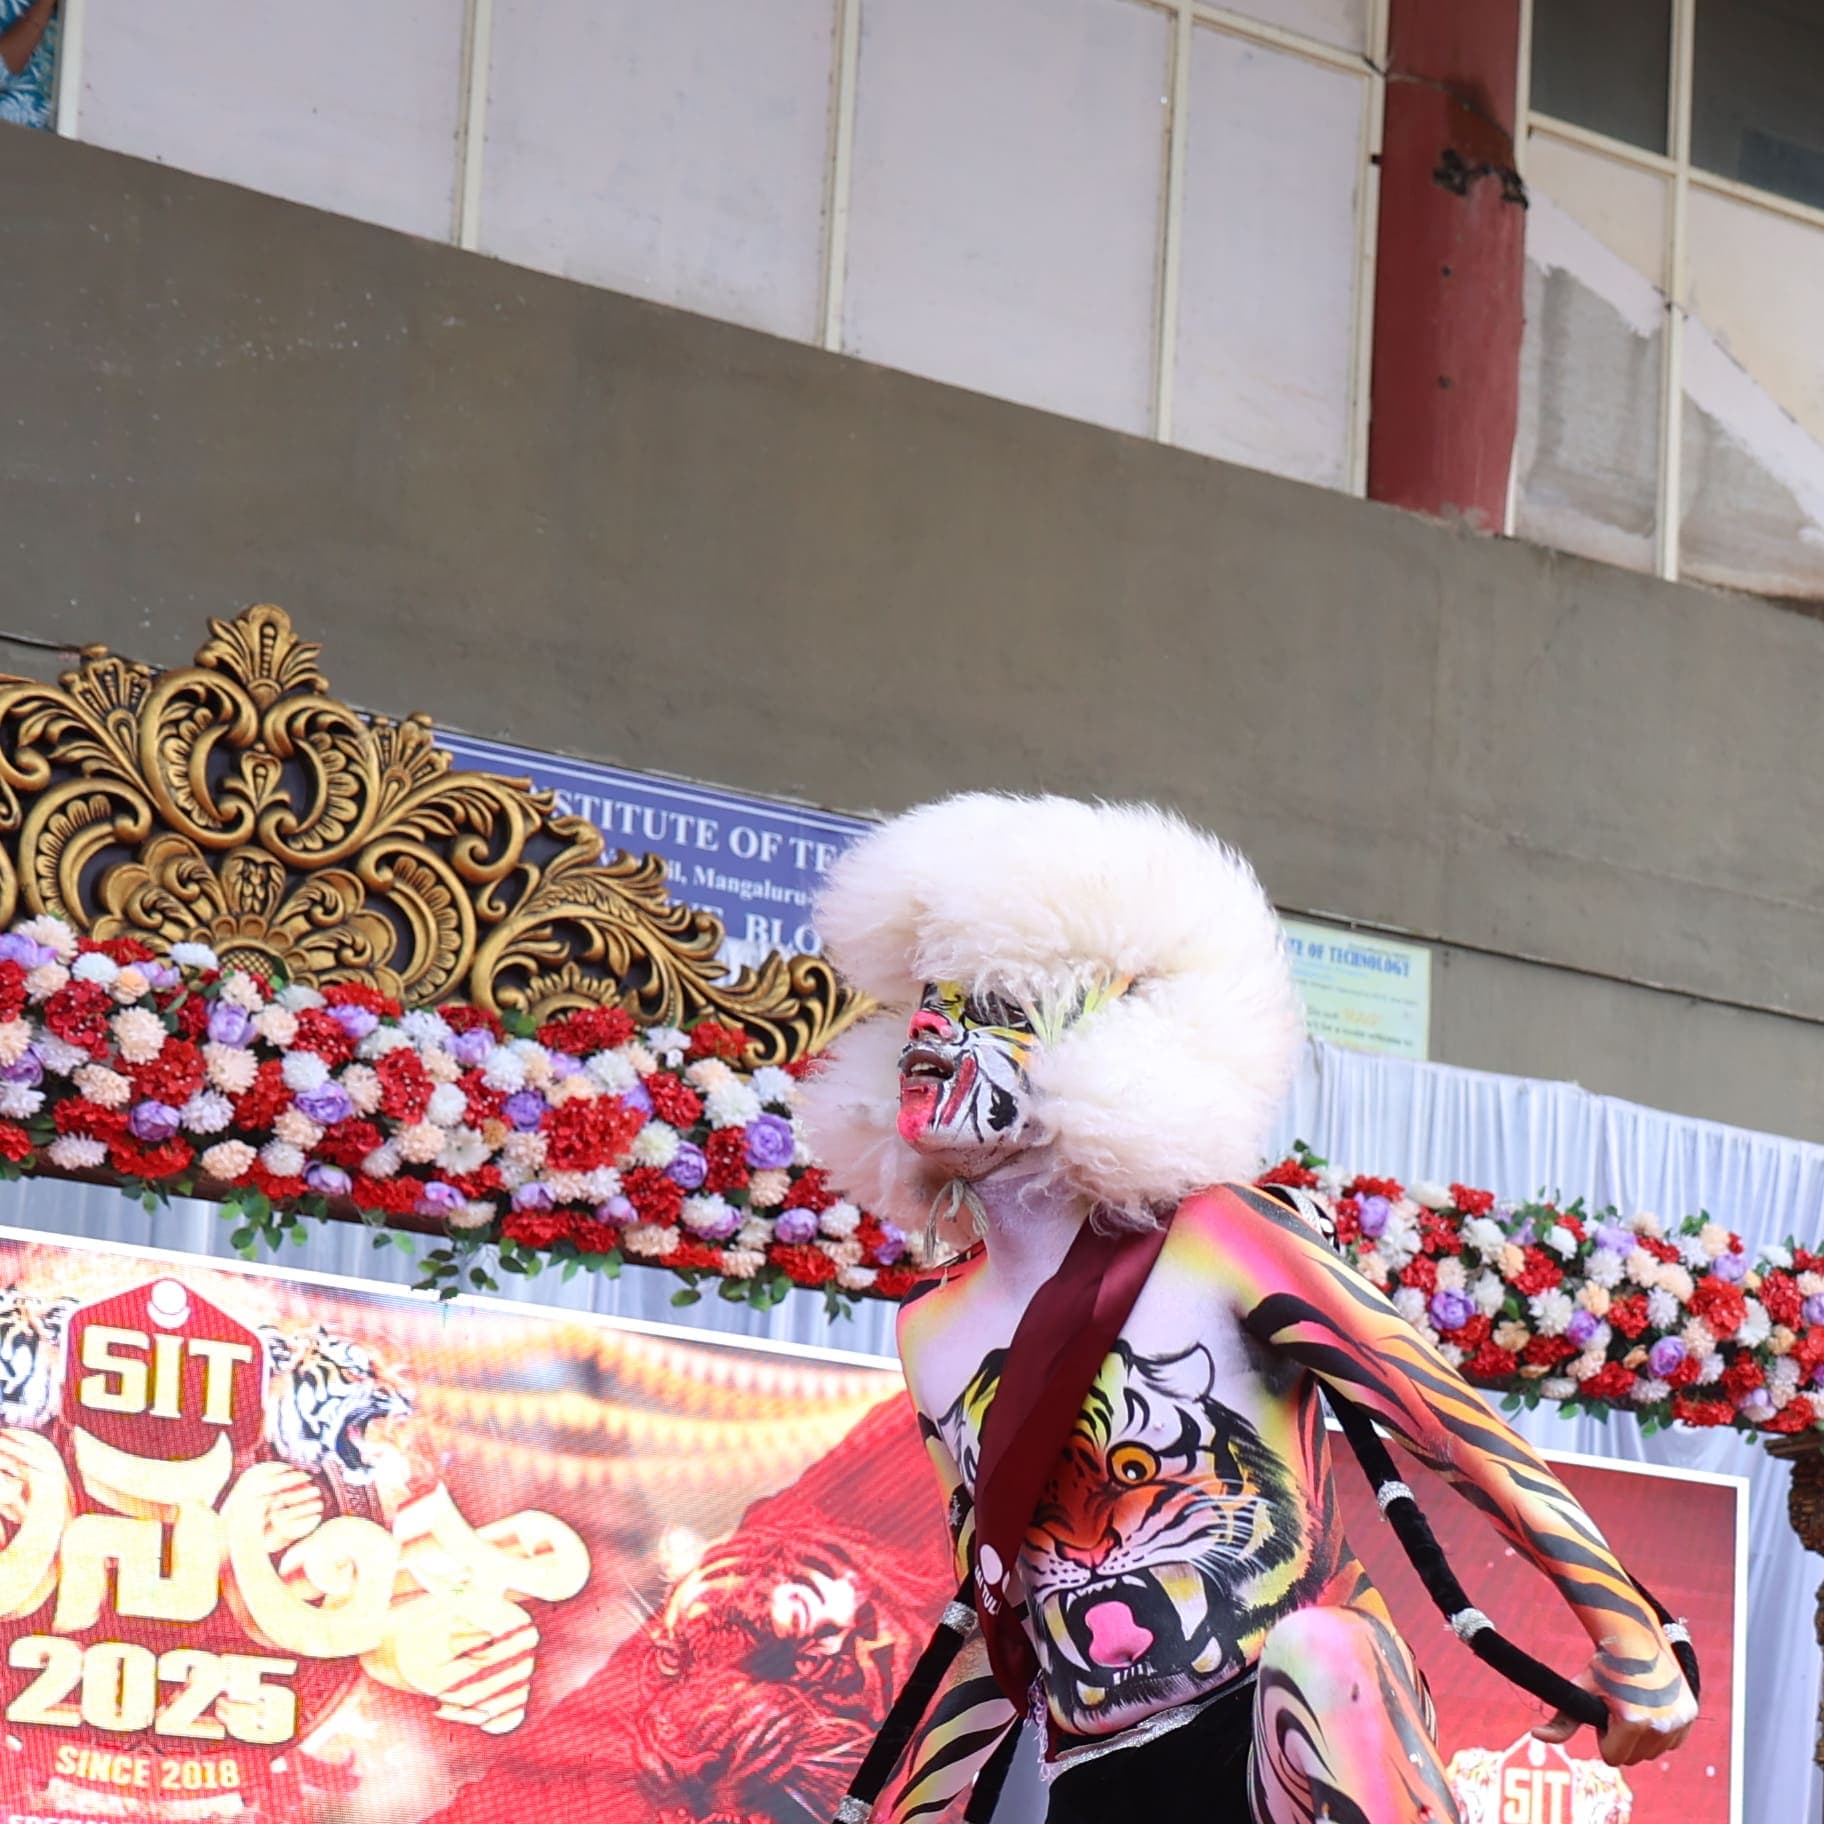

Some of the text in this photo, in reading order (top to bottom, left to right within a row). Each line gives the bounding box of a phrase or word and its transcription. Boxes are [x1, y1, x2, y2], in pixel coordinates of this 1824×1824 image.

[530, 786, 720, 852] STITUTE
[729, 825, 783, 863] OF
[745, 913, 822, 954] BLO
[79, 1325, 254, 1427] SIT
[6, 1633, 299, 1746] 2025
[54, 1744, 241, 1791] SINCE 2018
